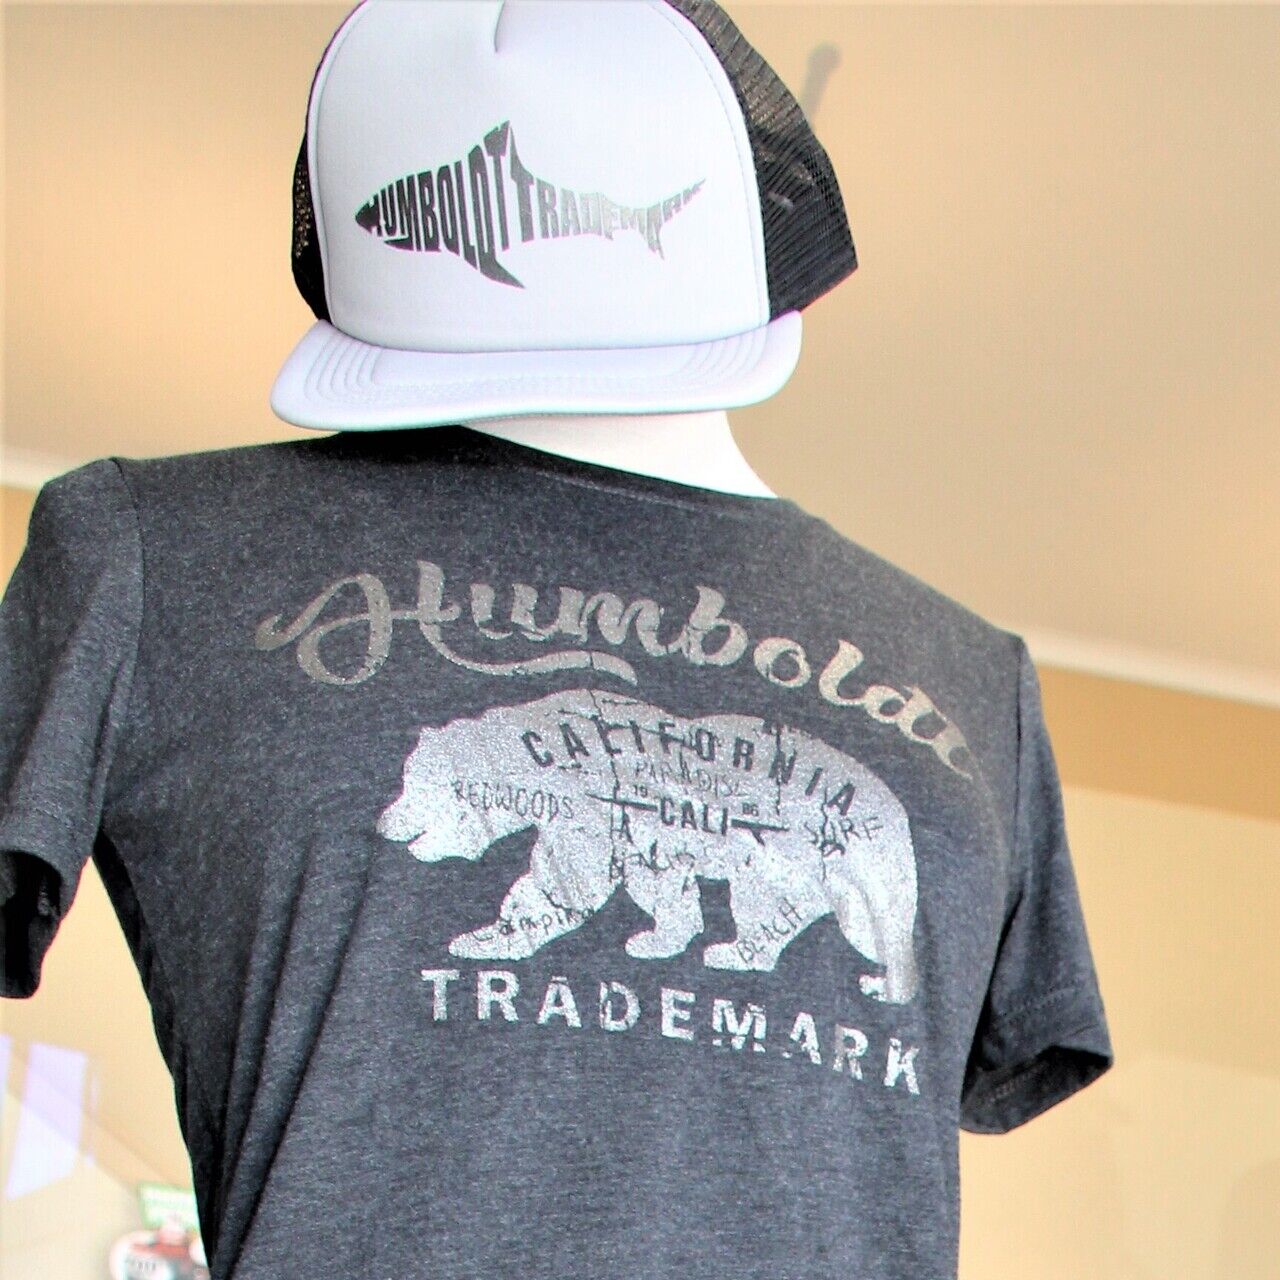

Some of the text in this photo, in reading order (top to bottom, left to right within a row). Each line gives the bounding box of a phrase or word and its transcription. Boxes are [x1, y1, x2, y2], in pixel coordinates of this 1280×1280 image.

[355, 121, 706, 289] HUMBOLDT TRADEMARK
[521, 718, 857, 818] CALIFORNIA
[658, 798, 729, 837] CALI
[420, 968, 921, 1096] TRADEMARK
